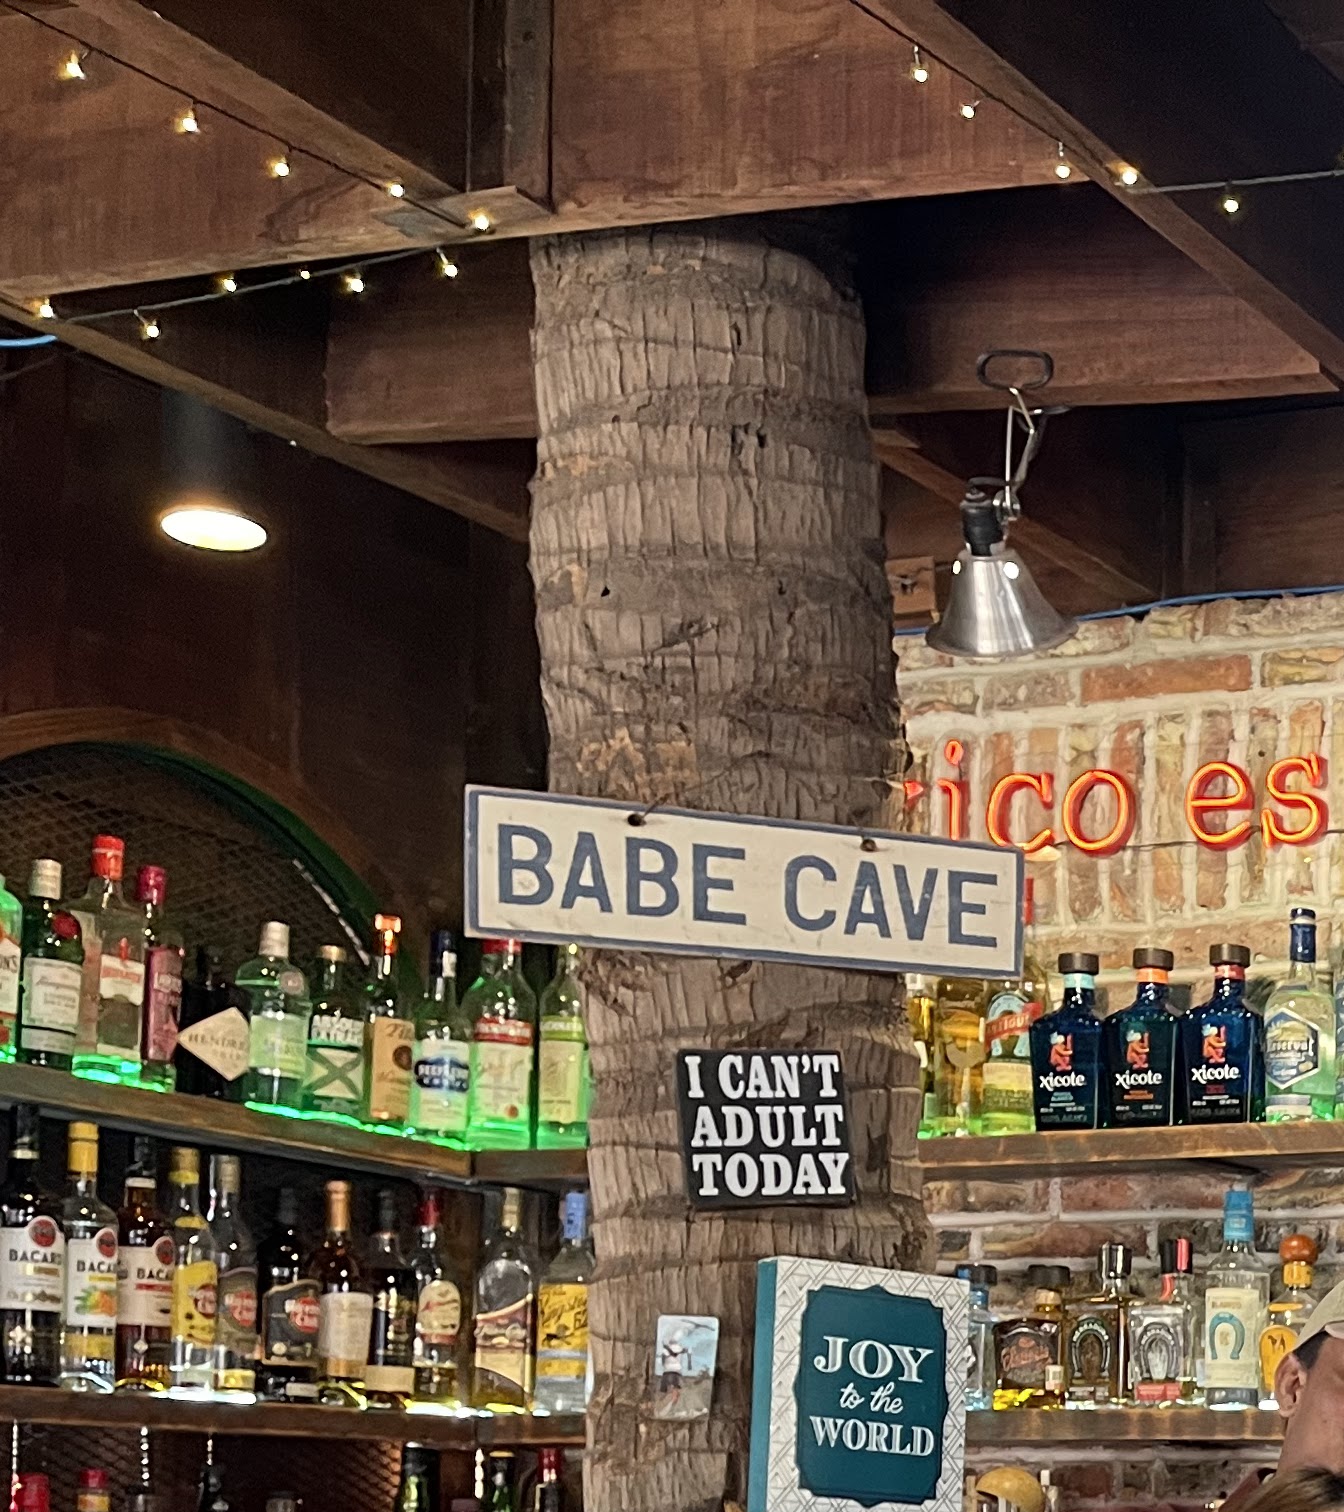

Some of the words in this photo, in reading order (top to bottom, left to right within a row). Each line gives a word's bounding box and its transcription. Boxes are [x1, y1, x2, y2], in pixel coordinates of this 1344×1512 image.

[906, 740, 1136, 856] ico
[1186, 756, 1326, 848] es
[498, 823, 747, 926] BABE
[784, 855, 998, 948] CAVE
[683, 1054, 704, 1099] I
[718, 1053, 841, 1099] CAN'T
[1039, 1071, 1086, 1091] xicote
[1115, 1068, 1164, 1090] xicote
[1191, 1063, 1241, 1086] xicote
[690, 1105, 844, 1148] ADULT
[692, 1152, 850, 1197] TODAY
[813, 1334, 935, 1384] JOY
[839, 1382, 864, 1412] to
[870, 1381, 904, 1414] the
[809, 1415, 936, 1457] WORLD
